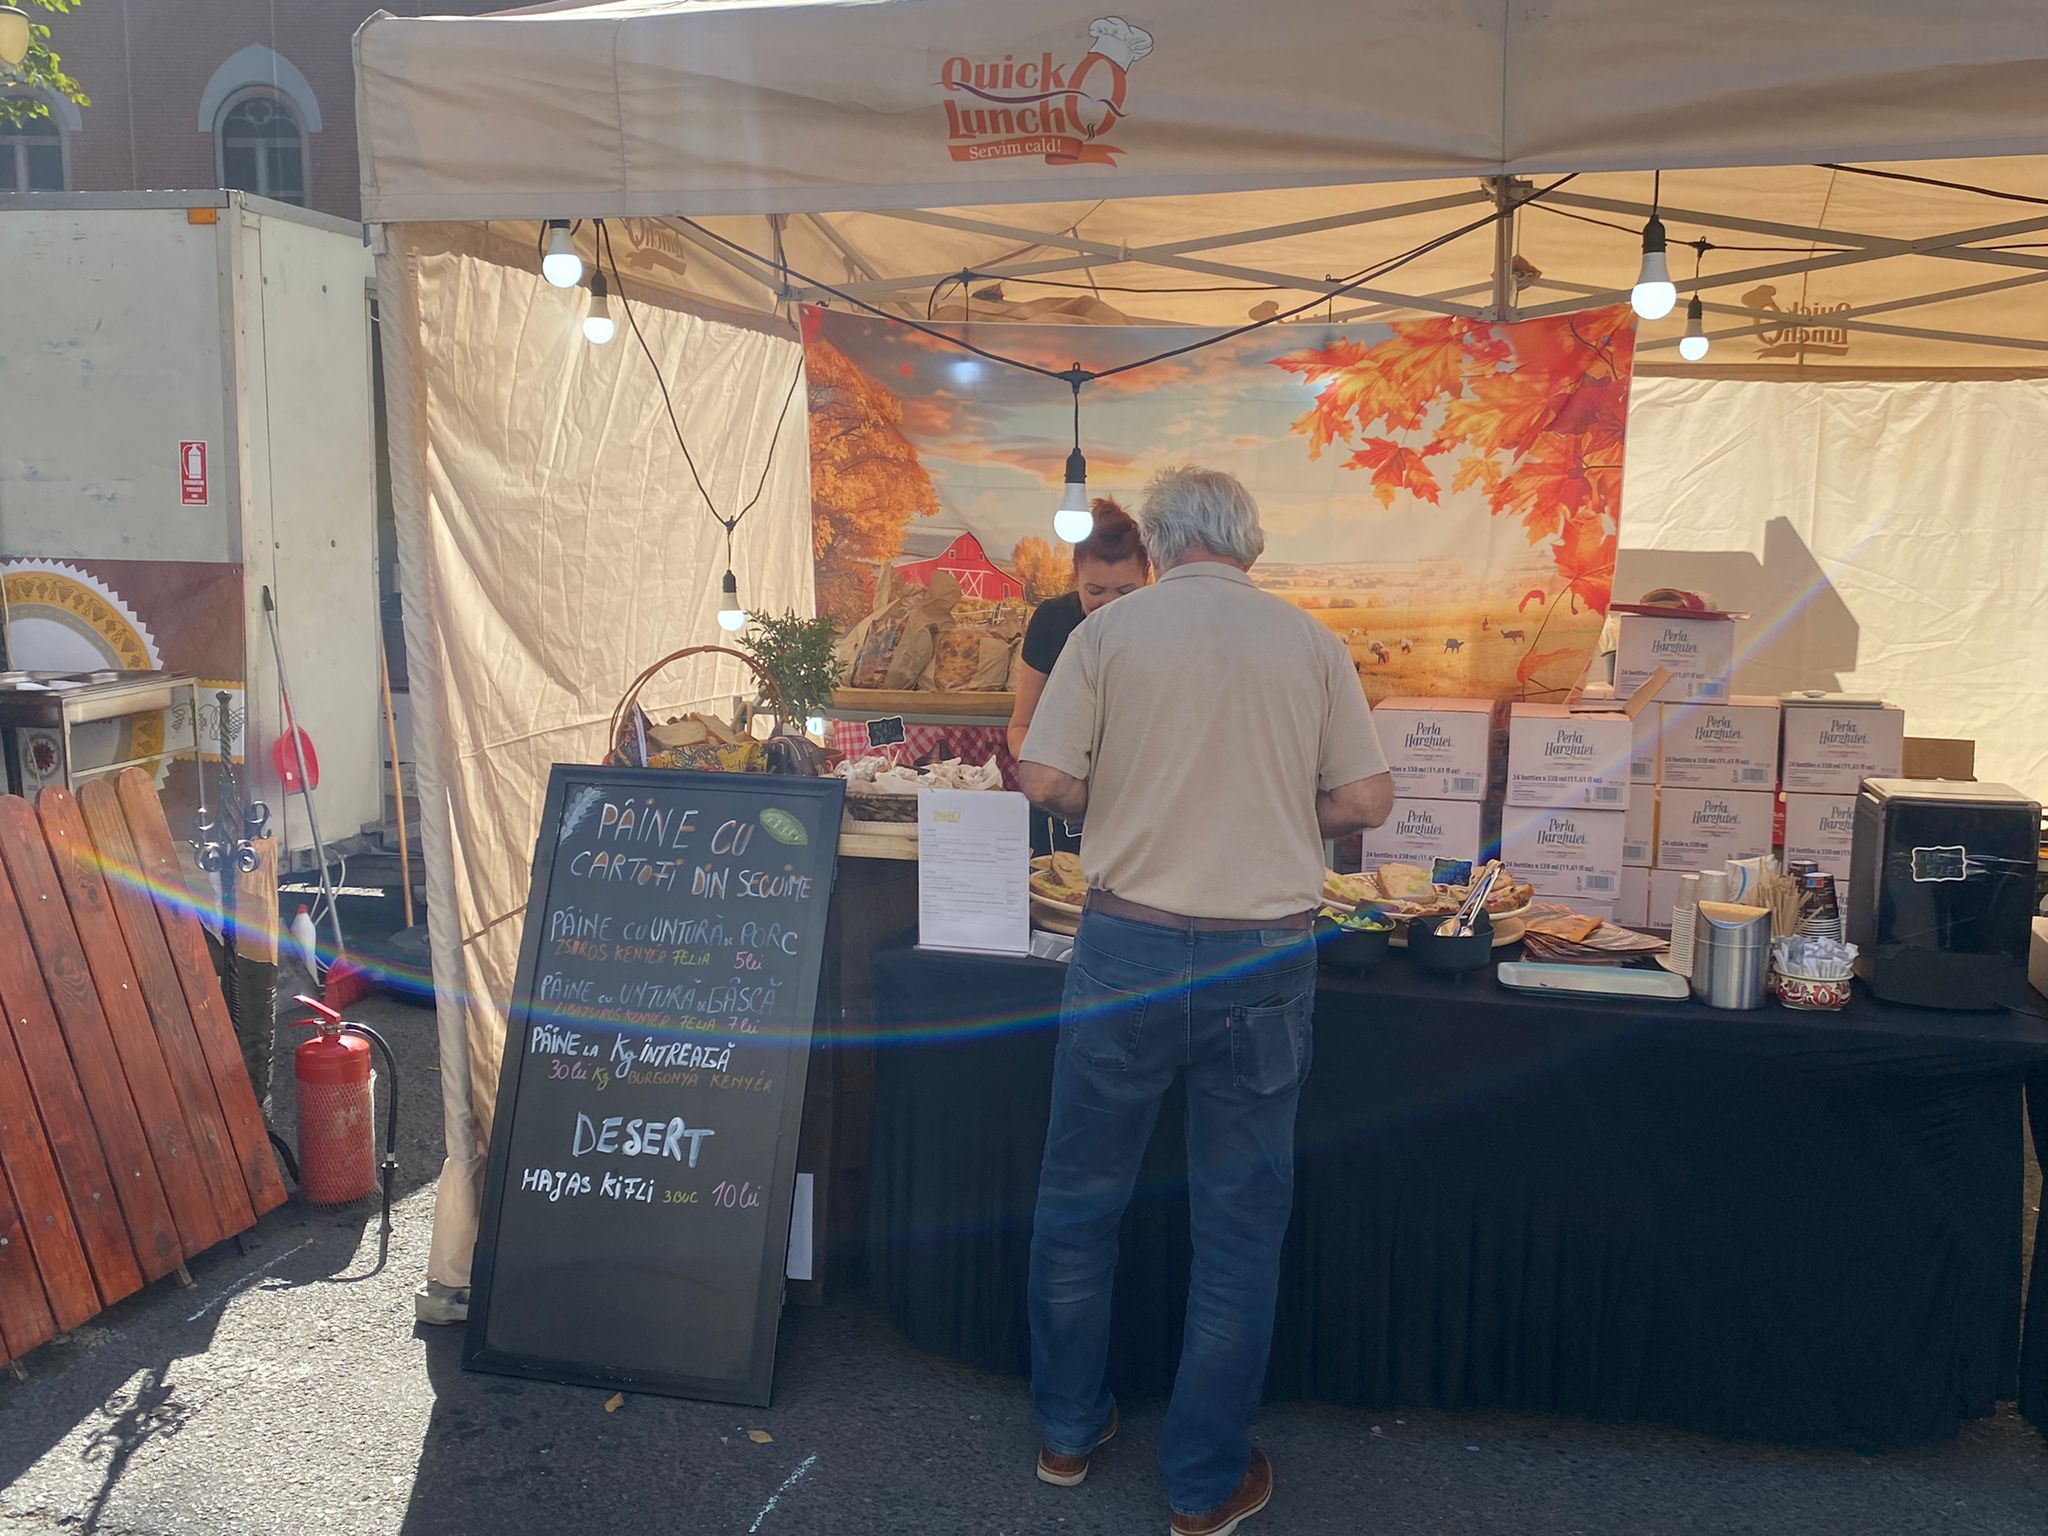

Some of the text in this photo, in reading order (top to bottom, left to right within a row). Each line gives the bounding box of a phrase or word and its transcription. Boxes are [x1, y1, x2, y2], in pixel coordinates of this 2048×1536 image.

[941, 52, 1067, 93] Quick
[943, 98, 1067, 139] Lunch
[969, 138, 1062, 160] Servim cald!
[1416, 722, 1441, 735] Perla
[1557, 730, 1583, 744] Perla
[598, 799, 699, 848] PÂINE
[711, 819, 755, 856] CU
[1408, 810, 1432, 824] Perla
[1549, 818, 1575, 832] Perla
[570, 851, 684, 892] CARTOFI
[691, 863, 730, 900] DIN
[550, 906, 613, 942] PÂINE
[740, 921, 798, 955] PORC
[672, 949, 711, 966] FELIA
[540, 971, 594, 1001] PÂINE
[680, 1015, 716, 1032] FELIA
[530, 1024, 581, 1056] PÂINE
[583, 1044, 599, 1057] LA
[571, 1111, 715, 1169] DESERT
[522, 1168, 592, 1202] HAJAS
